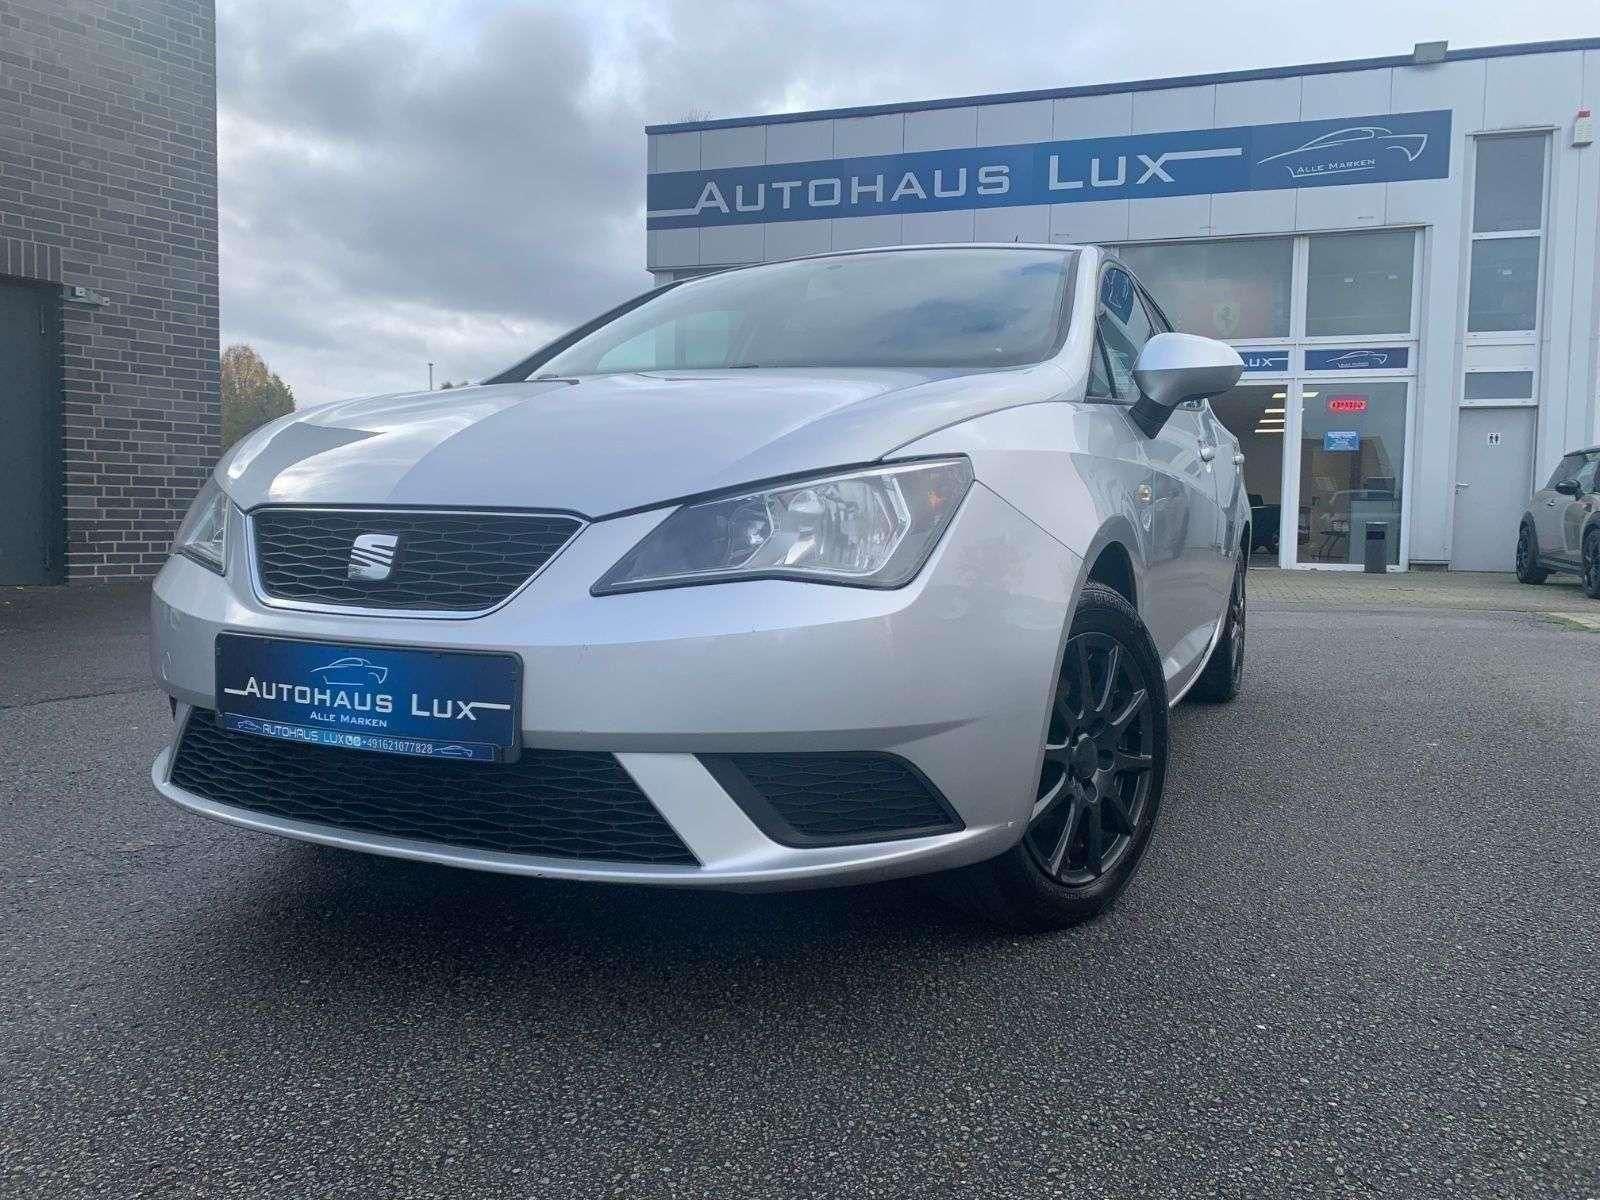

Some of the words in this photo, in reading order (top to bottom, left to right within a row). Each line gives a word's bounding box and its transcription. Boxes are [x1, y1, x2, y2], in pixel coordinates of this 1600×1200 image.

[1296, 164, 1325, 174] ALLE
[1328, 158, 1376, 170] MARKEN
[697, 165, 1010, 215] AUTOHAUS
[1048, 153, 1176, 192] LUX
[243, 676, 393, 714] AUTOHAUS
[411, 694, 477, 721] LUX
[310, 711, 336, 722] ALLE
[340, 714, 387, 728] MARKEN
[262, 723, 319, 741] AUTOHAUS
[323, 730, 344, 745] LUX
